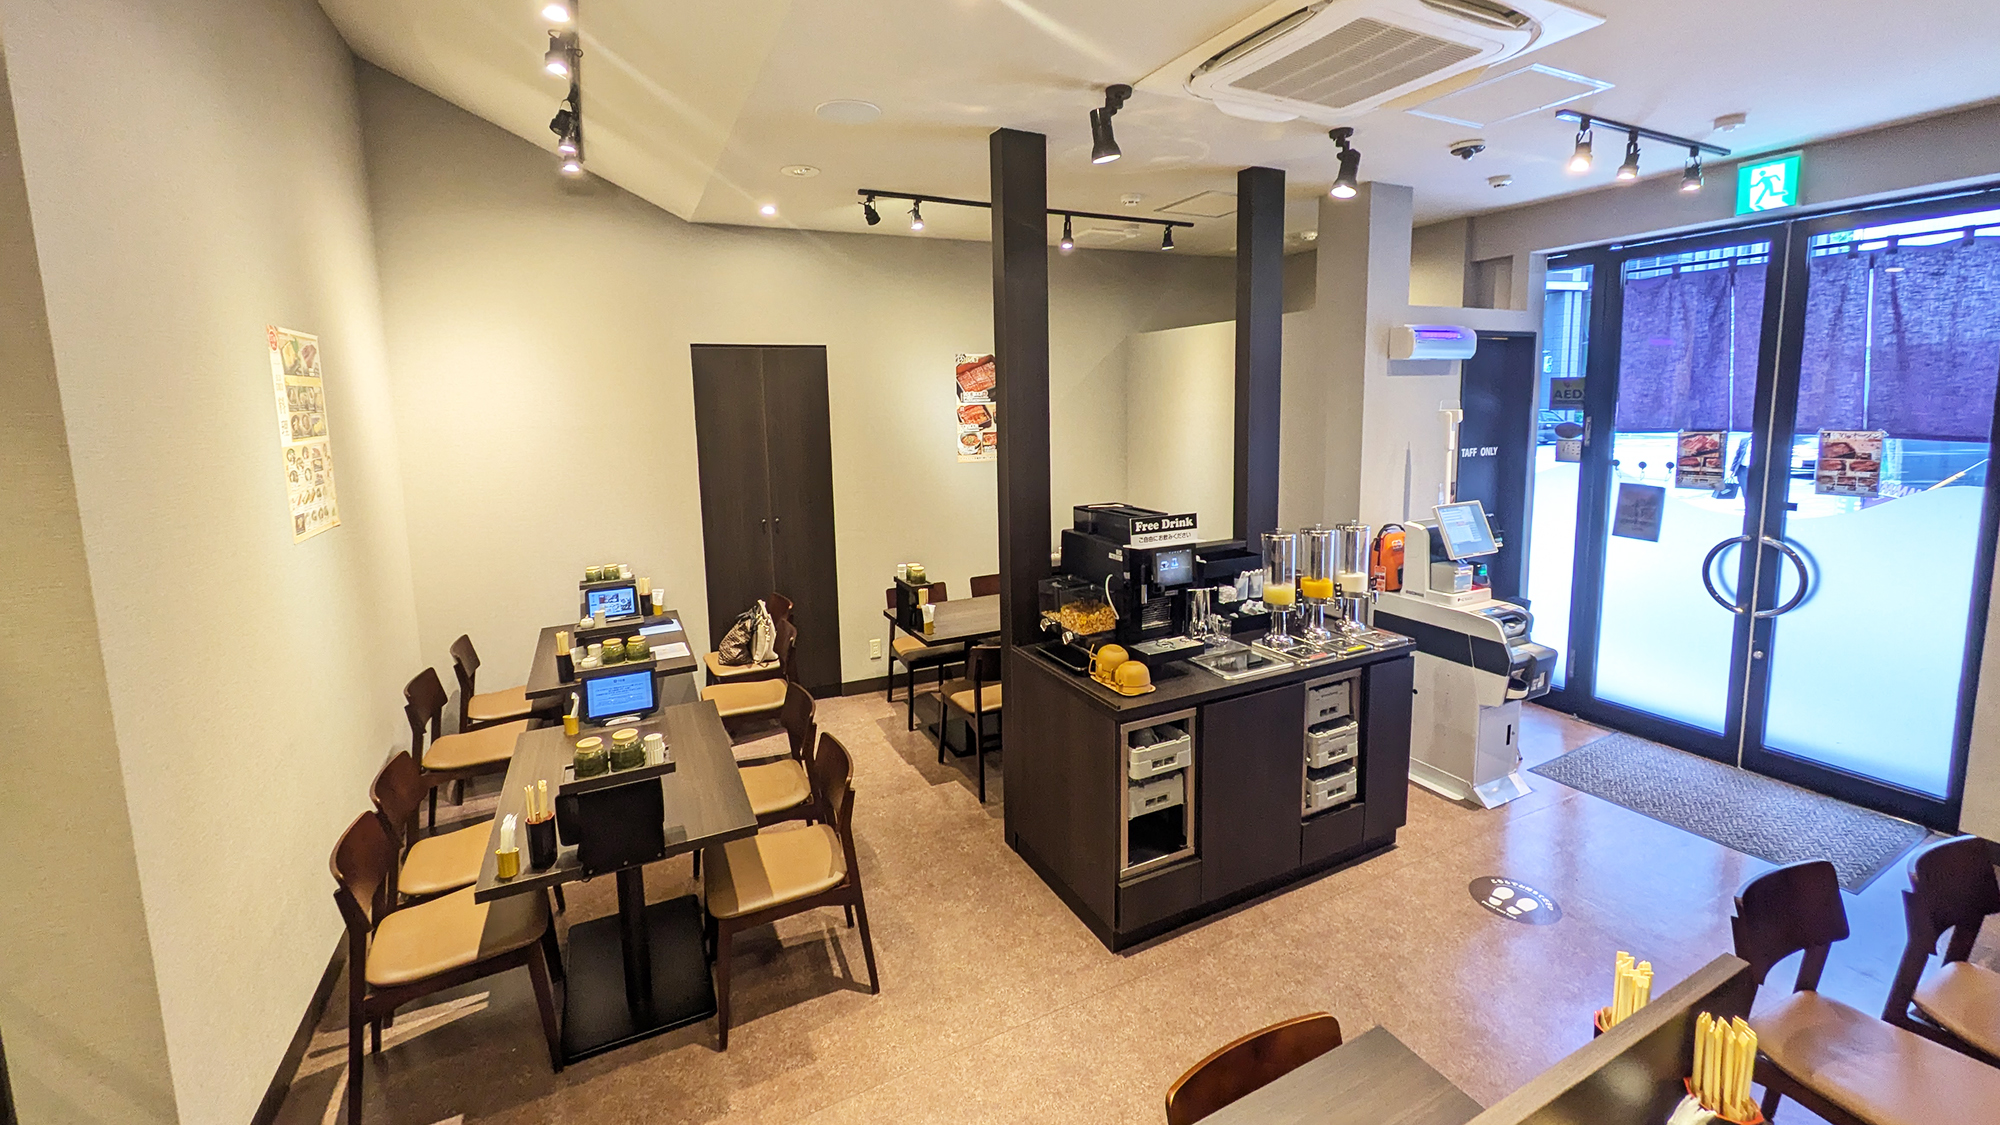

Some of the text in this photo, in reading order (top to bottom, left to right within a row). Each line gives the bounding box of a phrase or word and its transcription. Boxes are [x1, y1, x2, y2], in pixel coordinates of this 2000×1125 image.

[1553, 389, 1582, 399] AED
[1461, 446, 1499, 458] TAFF ONLY
[1135, 517, 1194, 532] Free Drink
